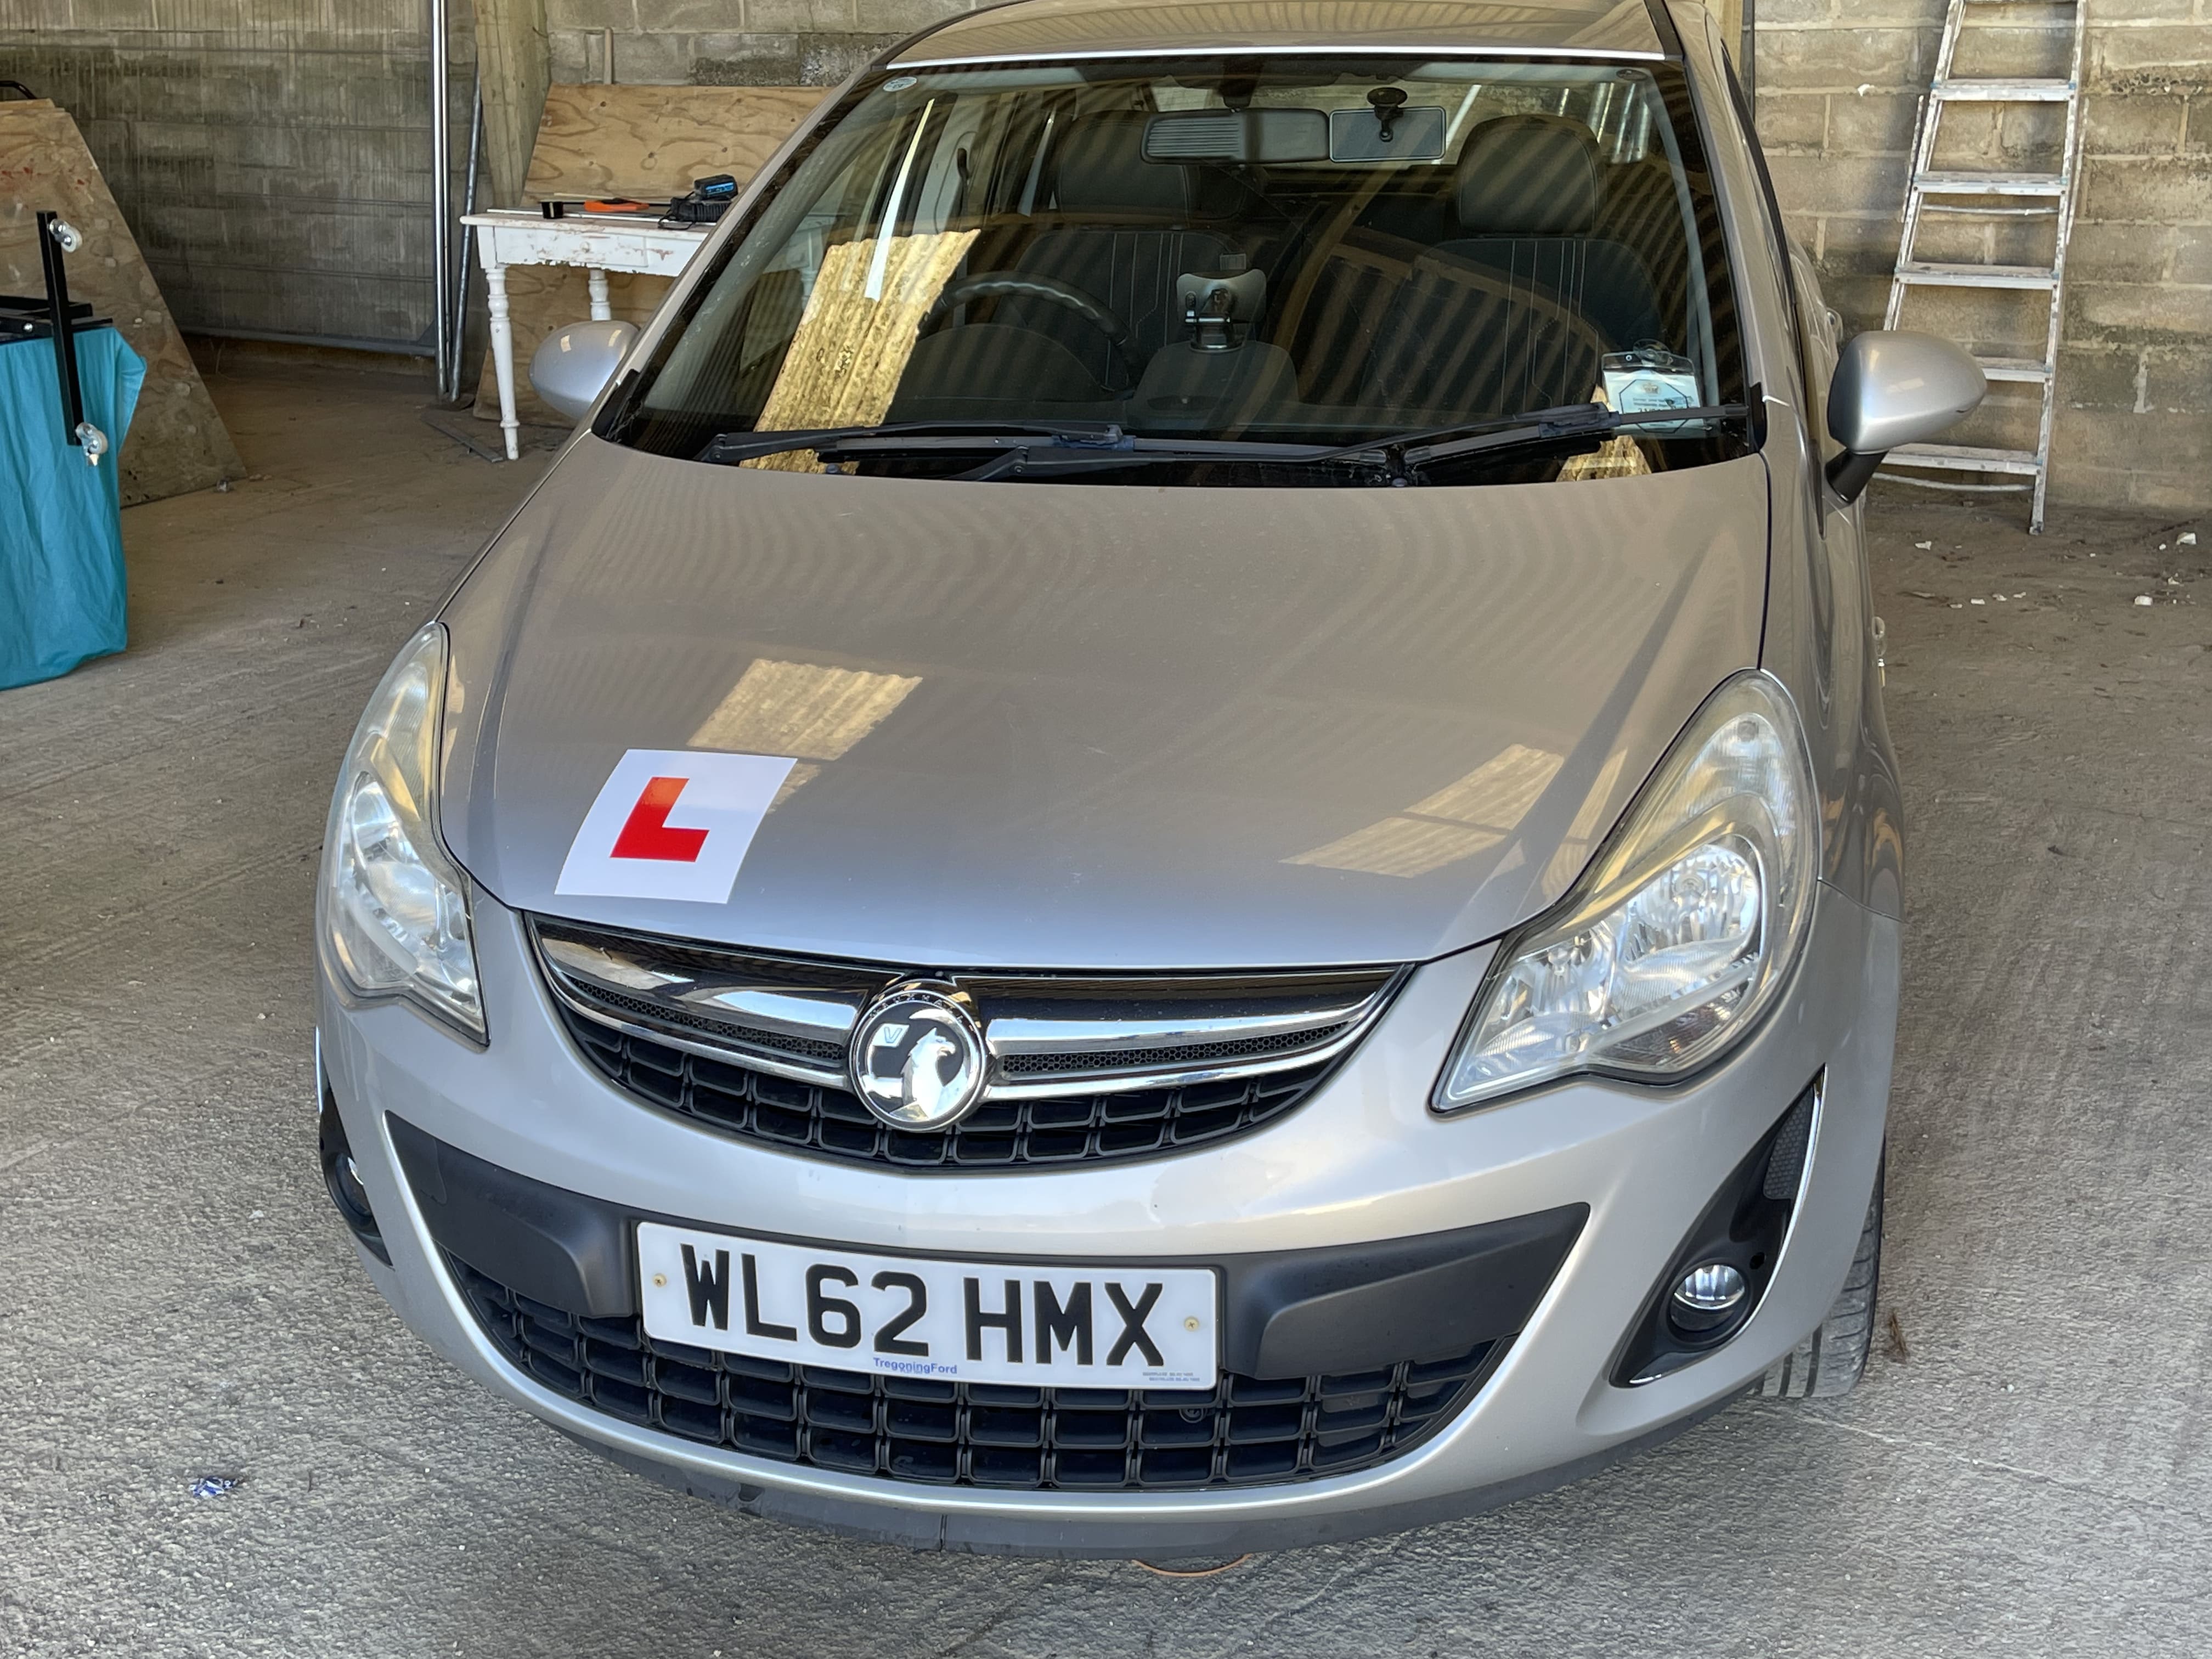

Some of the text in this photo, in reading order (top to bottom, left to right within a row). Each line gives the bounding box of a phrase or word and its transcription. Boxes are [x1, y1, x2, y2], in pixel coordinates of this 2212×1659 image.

[610, 777, 710, 862] L
[680, 1243, 1164, 1367] WL62 HMX
[873, 1358, 957, 1374] TregoningFord
